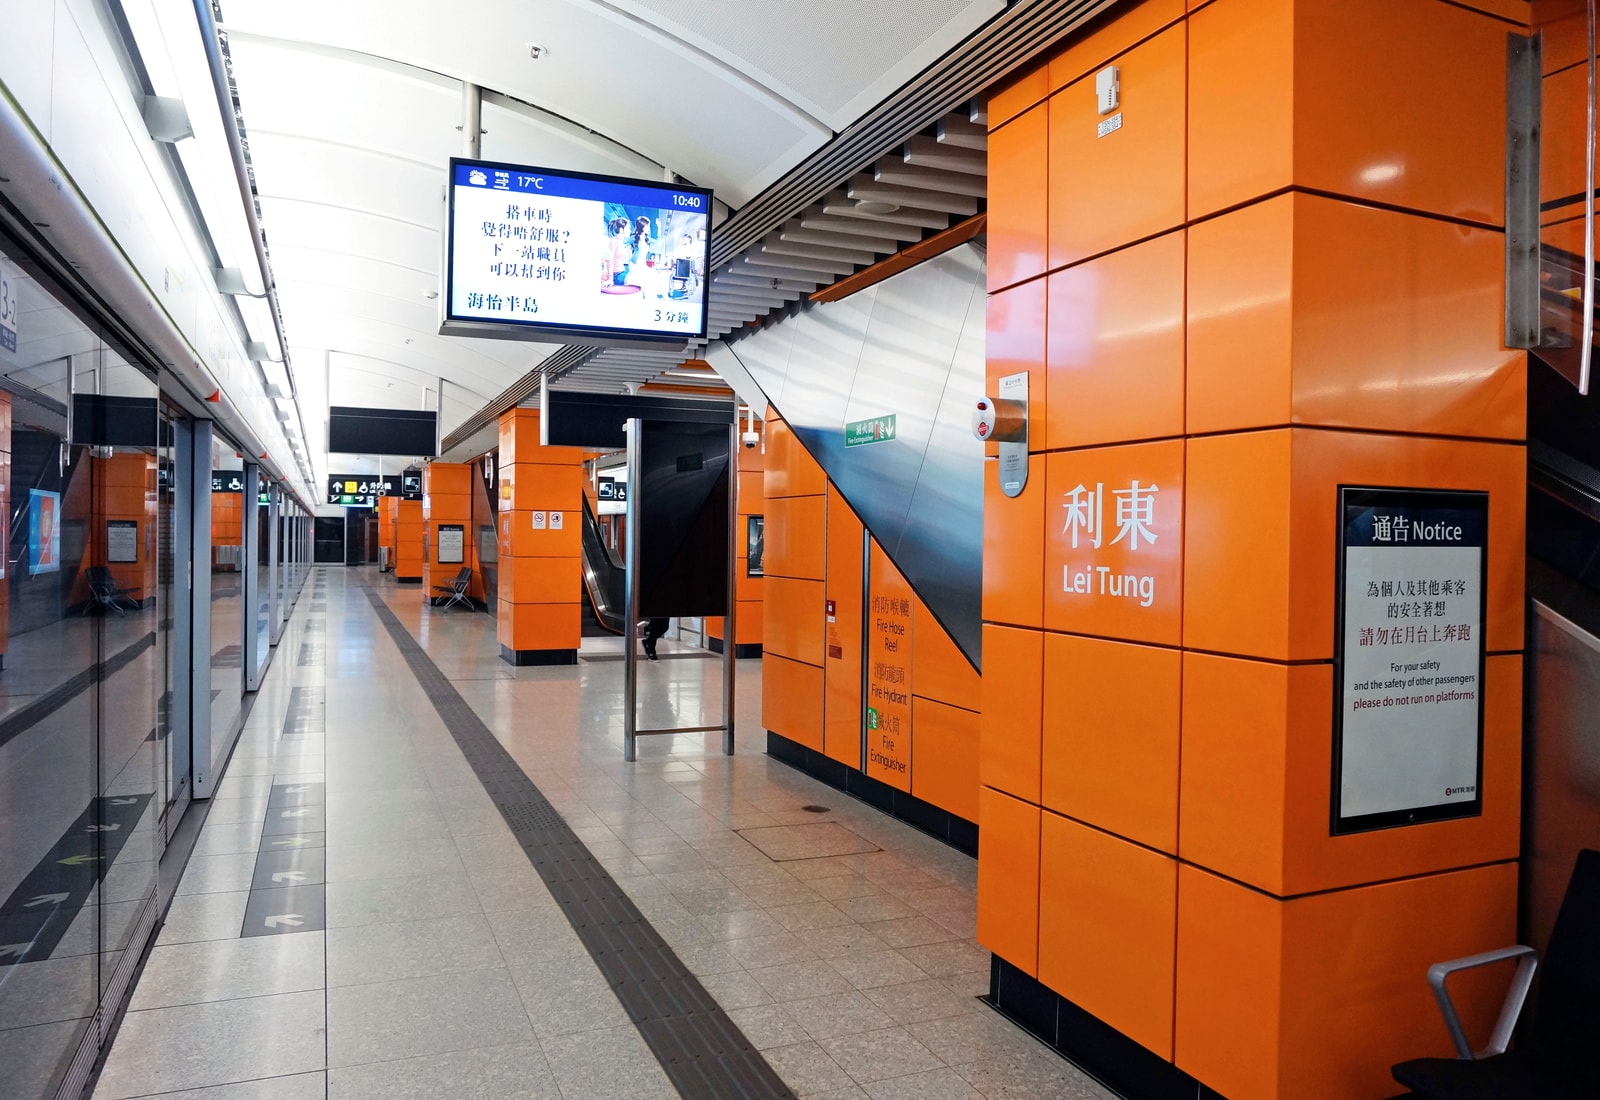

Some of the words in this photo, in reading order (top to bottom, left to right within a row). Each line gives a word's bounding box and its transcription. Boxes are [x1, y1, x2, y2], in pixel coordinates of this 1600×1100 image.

[517, 176, 544, 189] 17°C
[672, 195, 701, 208] 10:40
[506, 204, 552, 223] 搭車時
[492, 243, 566, 263] 下一站職員
[490, 262, 566, 281] 可以幫到你
[467, 292, 538, 313] 海怡半島
[1062, 480, 1159, 551] 利東
[1372, 515, 1410, 542] 通告
[1413, 521, 1463, 541] Notice
[1063, 564, 1092, 594] Lei
[1096, 566, 1154, 607] Tung
[1367, 579, 1466, 598] 為個人及其他乘客
[1387, 601, 1446, 619] 的安全著想
[876, 618, 888, 633] Fire
[889, 621, 905, 636] Hose
[1359, 623, 1471, 647] 請勿在月台上奔跑
[884, 637, 898, 653] Reel
[874, 662, 905, 685] 消防龍頭
[1390, 662, 1402, 673] For
[1404, 663, 1419, 674] your
[1420, 660, 1441, 672] safety
[1353, 681, 1369, 691] and
[1370, 679, 1383, 690] the
[1384, 678, 1406, 690] safety
[1407, 677, 1415, 687] of
[1415, 676, 1434, 686] other
[1435, 675, 1475, 686] passengers
[871, 683, 882, 699] Fire
[883, 687, 908, 706] Hydrant
[1353, 698, 1381, 711] please
[1383, 696, 1394, 707] do
[1395, 695, 1409, 706] not
[1410, 695, 1423, 705] run
[1425, 694, 1435, 704] on
[1436, 690, 1475, 704] platforms
[877, 712, 900, 735] 滅火筒
[882, 735, 895, 752] Fire
[870, 748, 906, 774] Extinguisher
